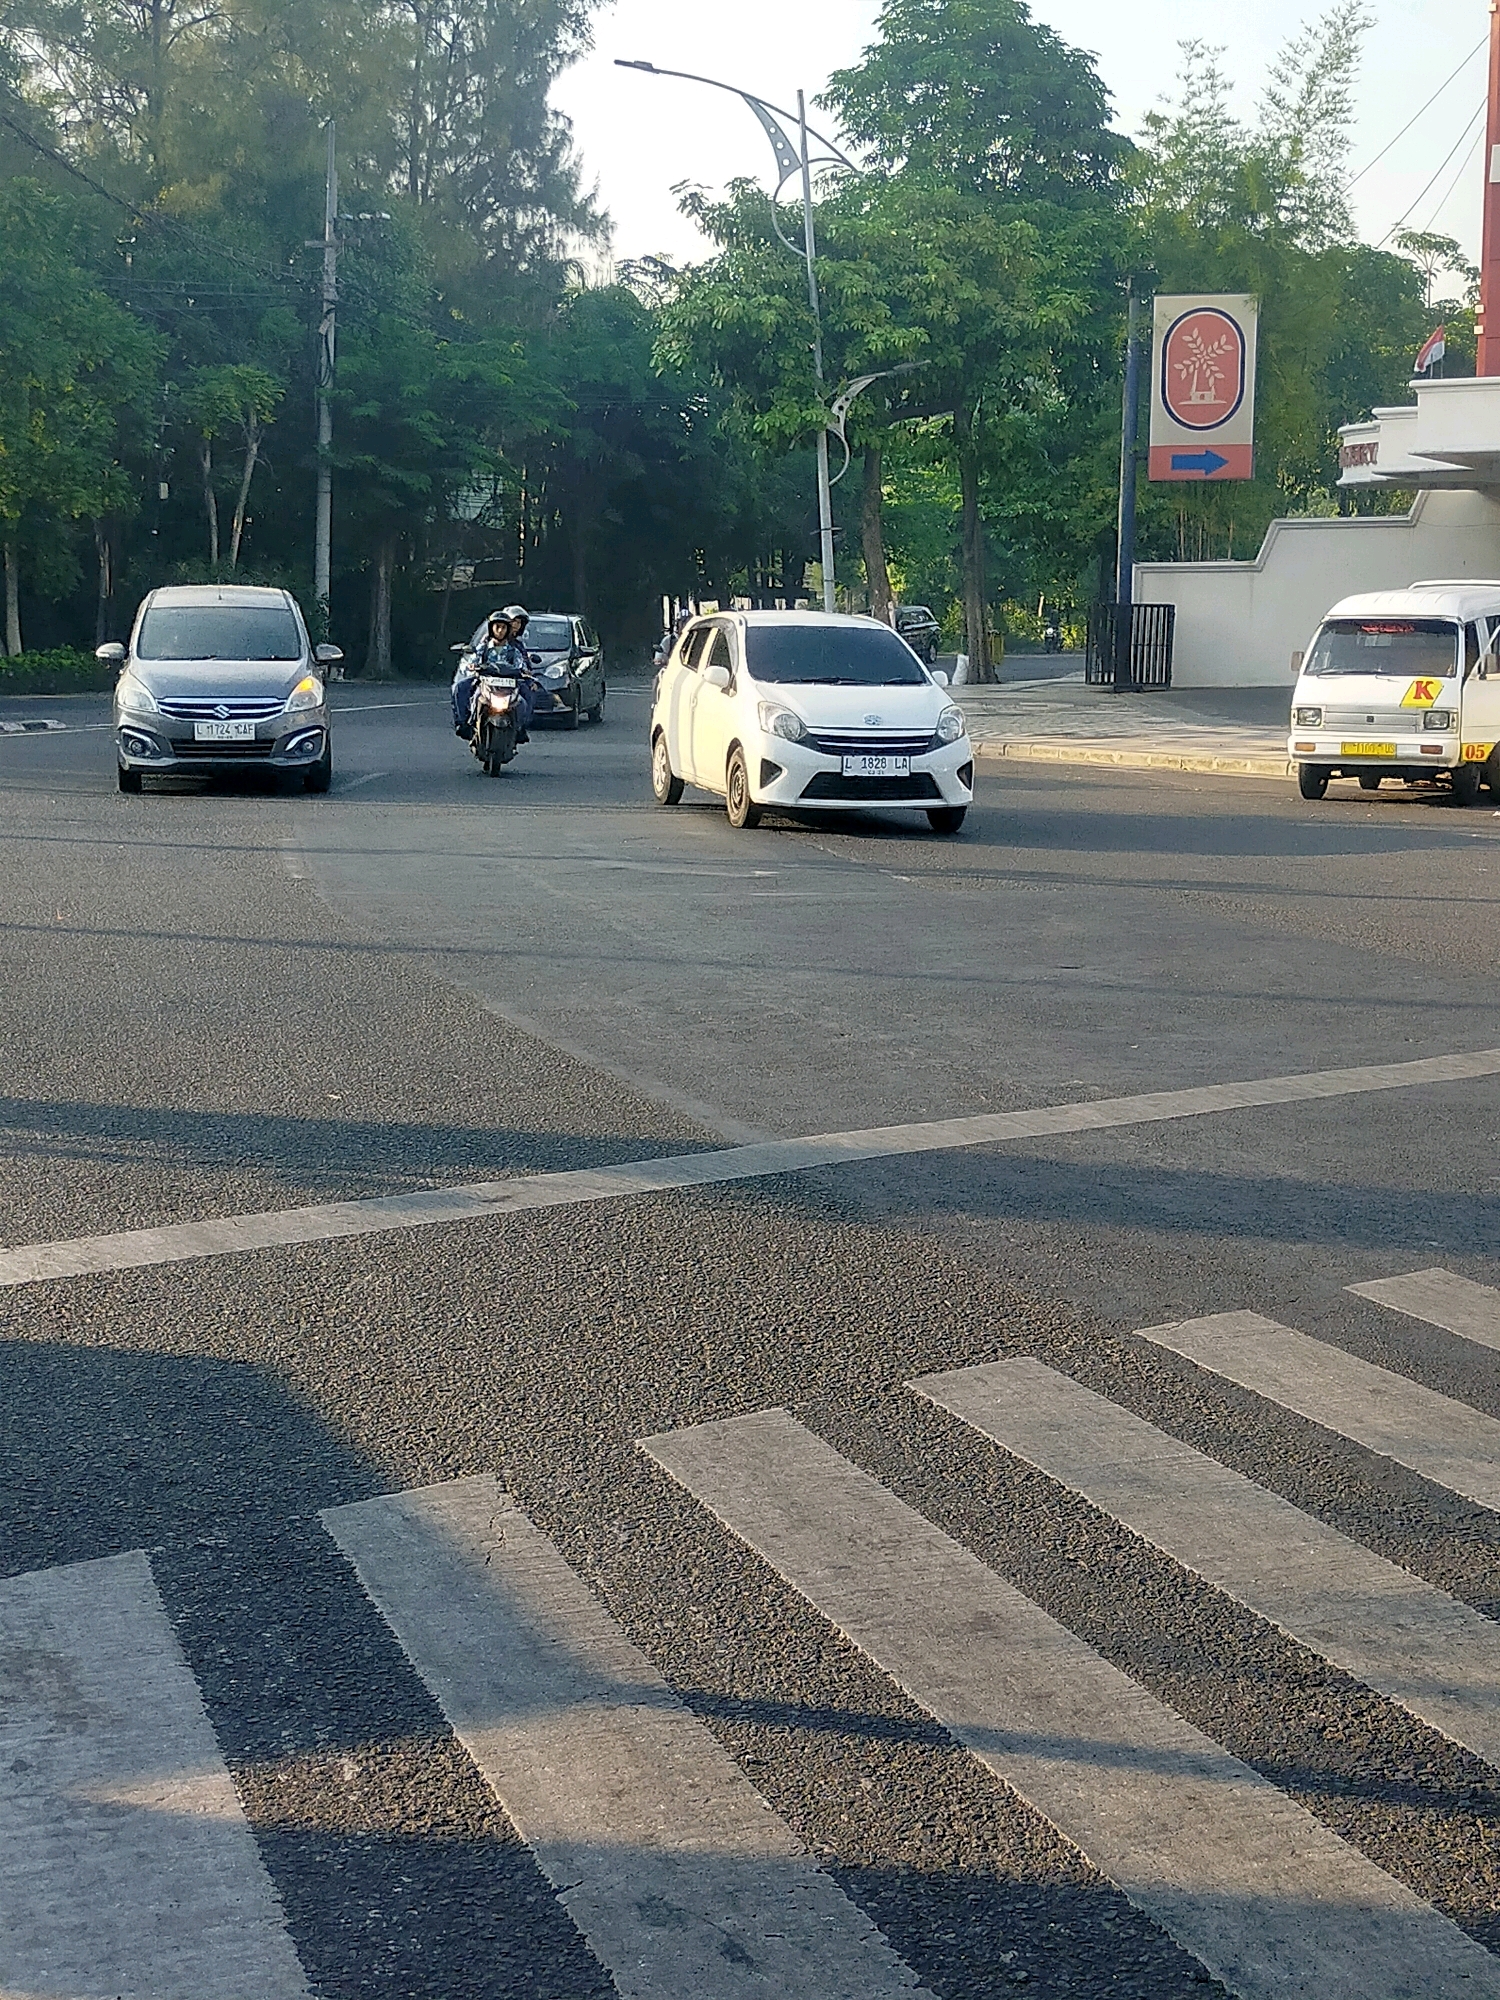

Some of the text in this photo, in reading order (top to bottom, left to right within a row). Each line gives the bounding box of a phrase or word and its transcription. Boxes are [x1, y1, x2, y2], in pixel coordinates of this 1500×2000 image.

[1413, 681, 1434, 700] K
[1465, 744, 1485, 760] 05
[845, 757, 908, 769] L 1828 LA
